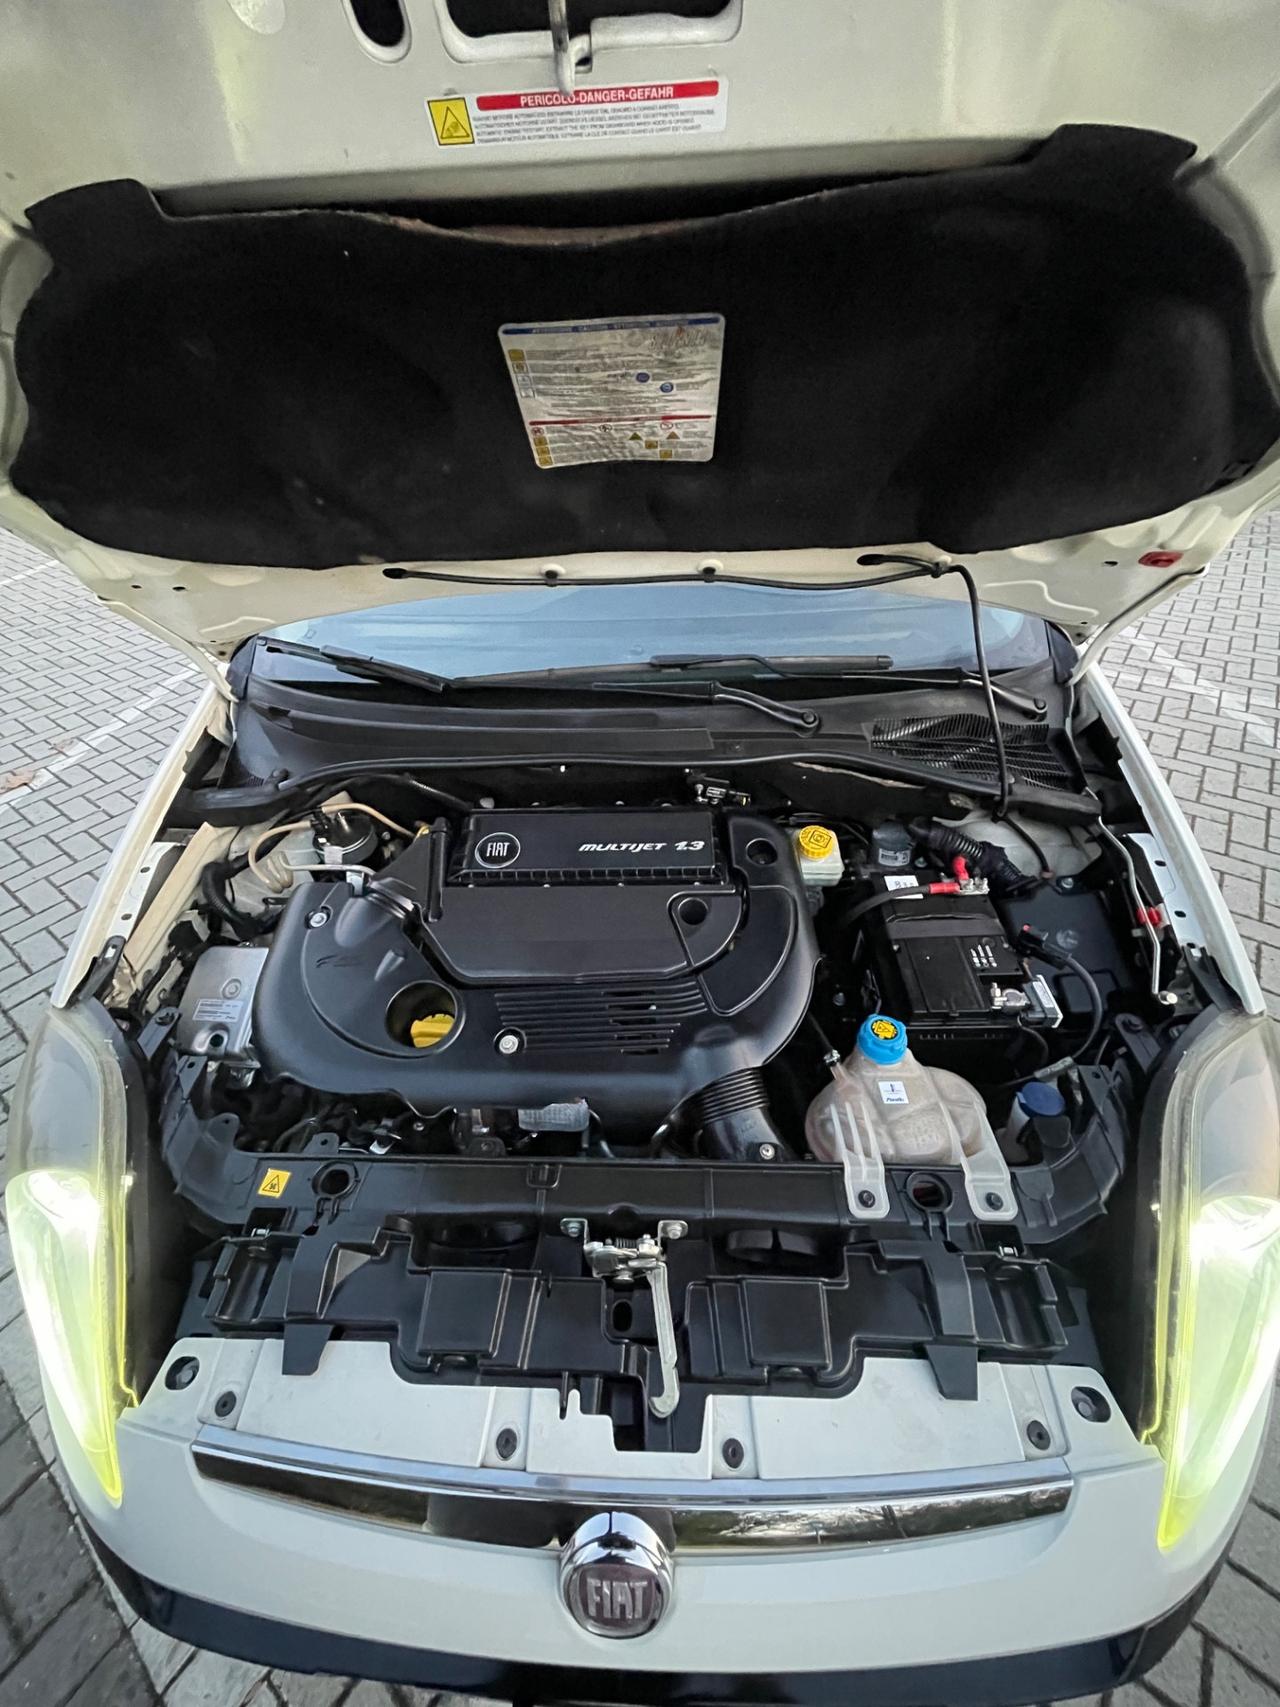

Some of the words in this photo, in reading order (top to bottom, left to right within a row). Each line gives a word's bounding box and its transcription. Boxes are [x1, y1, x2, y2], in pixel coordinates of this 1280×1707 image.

[520, 87, 674, 107] PERICOLO-DANGER-GEFAHR
[486, 842, 510, 857] FIAT
[586, 1578, 648, 1619] FIAT
